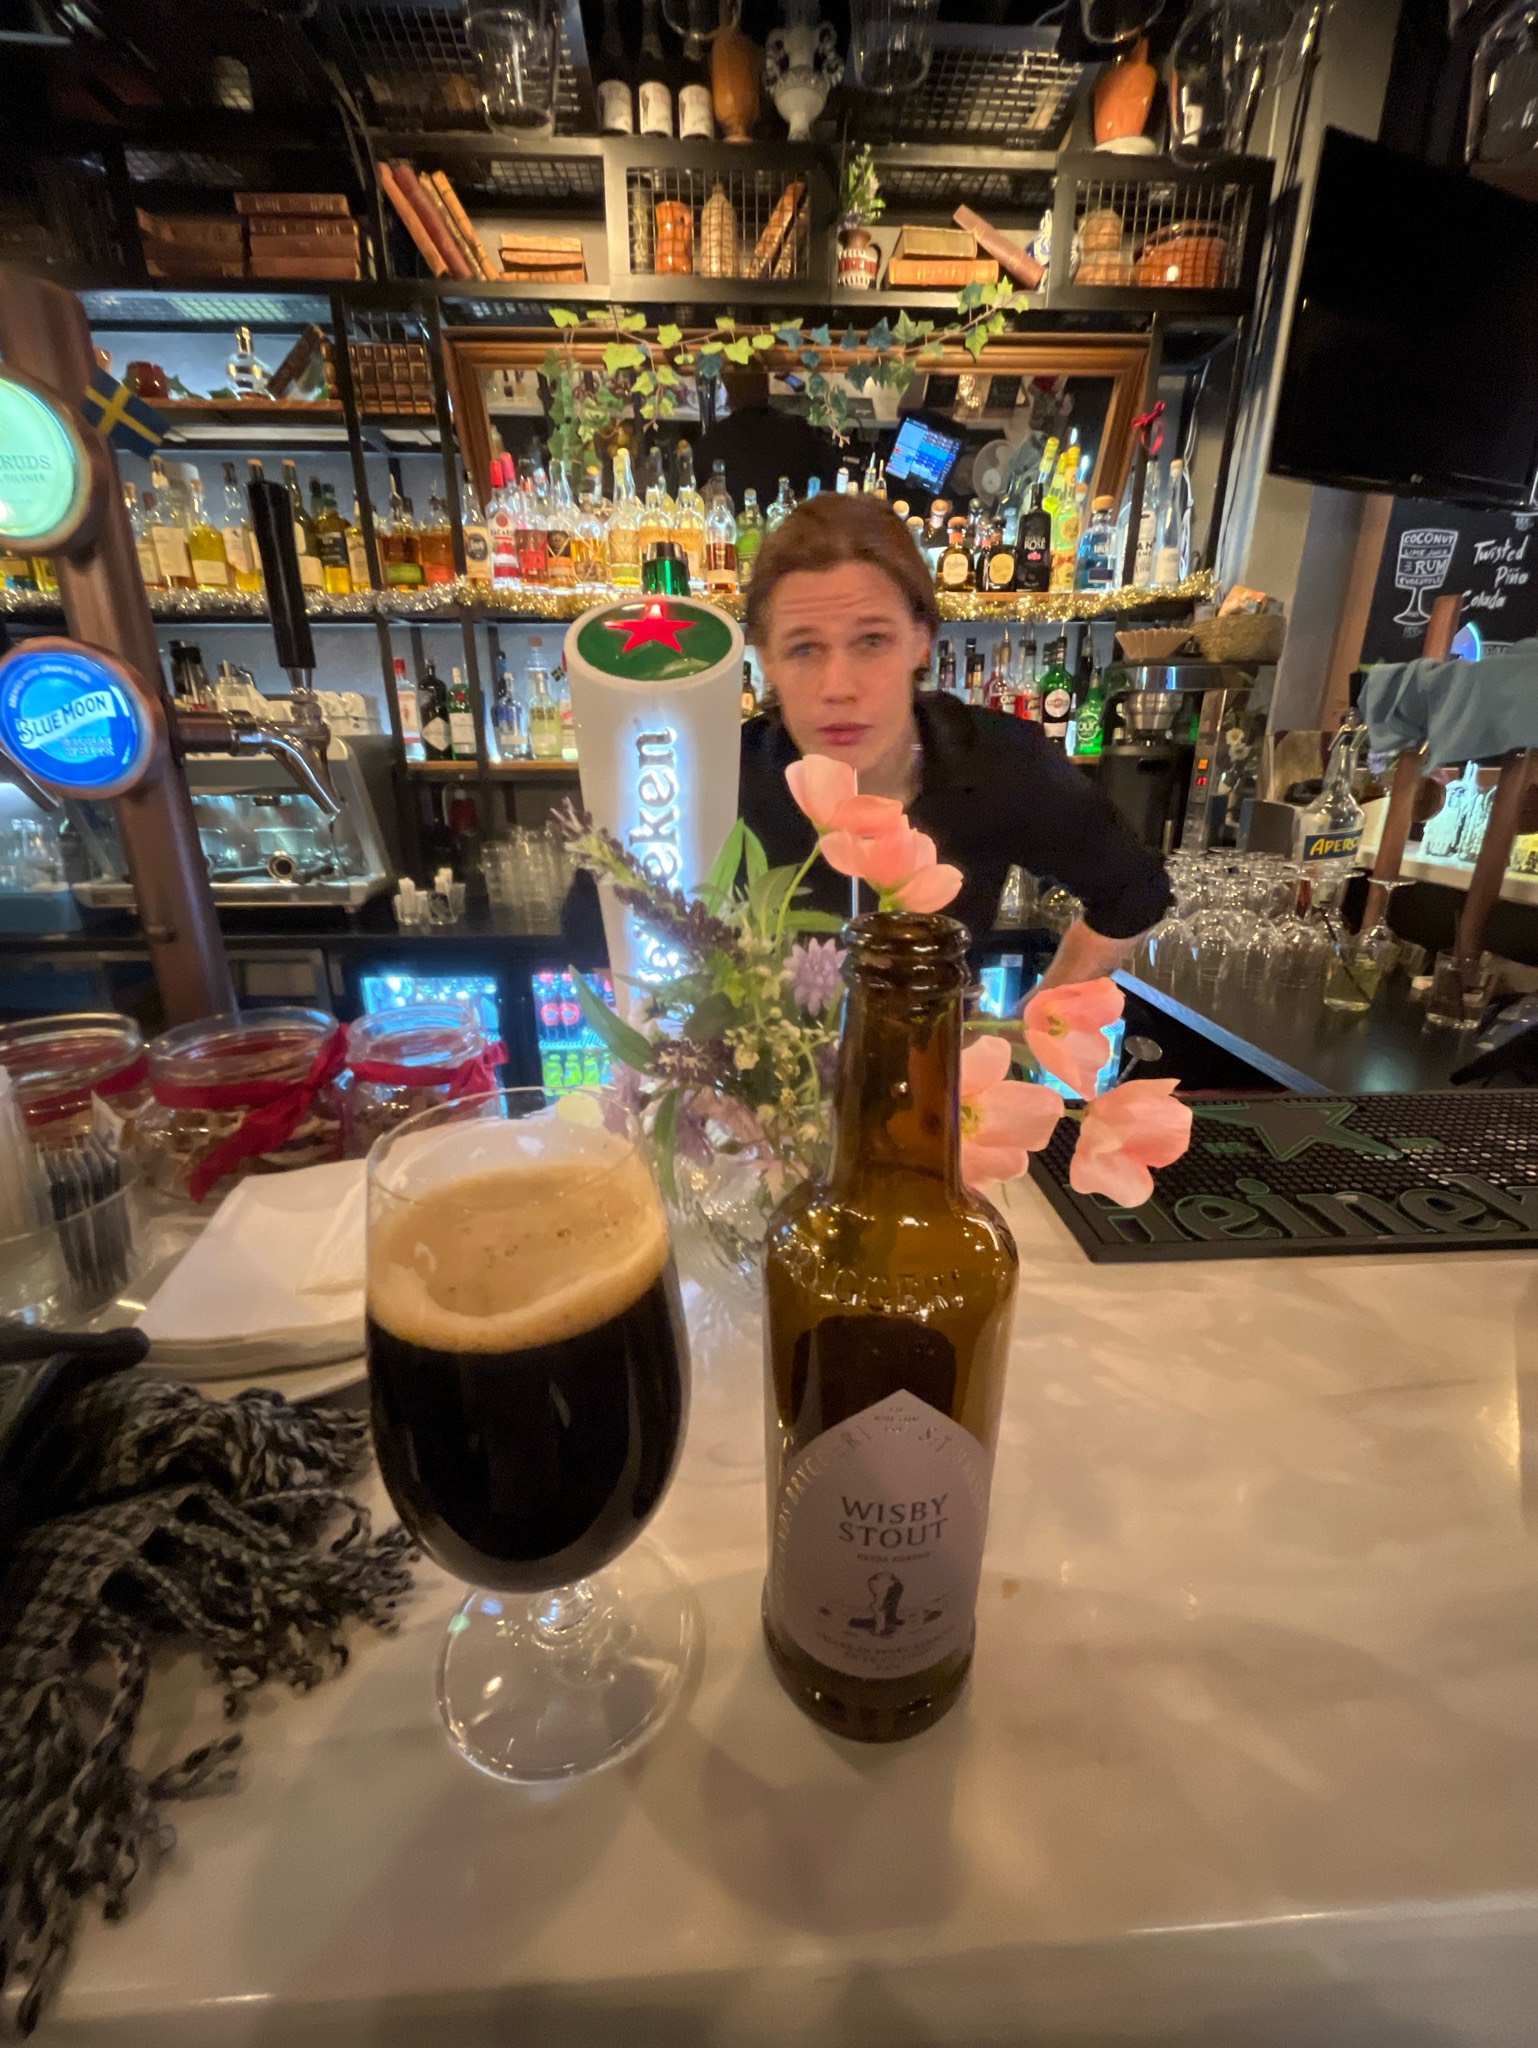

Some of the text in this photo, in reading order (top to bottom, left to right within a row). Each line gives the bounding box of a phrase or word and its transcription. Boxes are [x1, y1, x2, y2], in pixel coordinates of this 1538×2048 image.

[1404, 533, 1454, 545] COCONUT
[1473, 534, 1530, 565] Twisted
[1415, 560, 1449, 575] RUM
[16, 694, 108, 745] BLUE MOON
[840, 1493, 949, 1525] WISBY
[838, 1518, 948, 1549] STOUT
